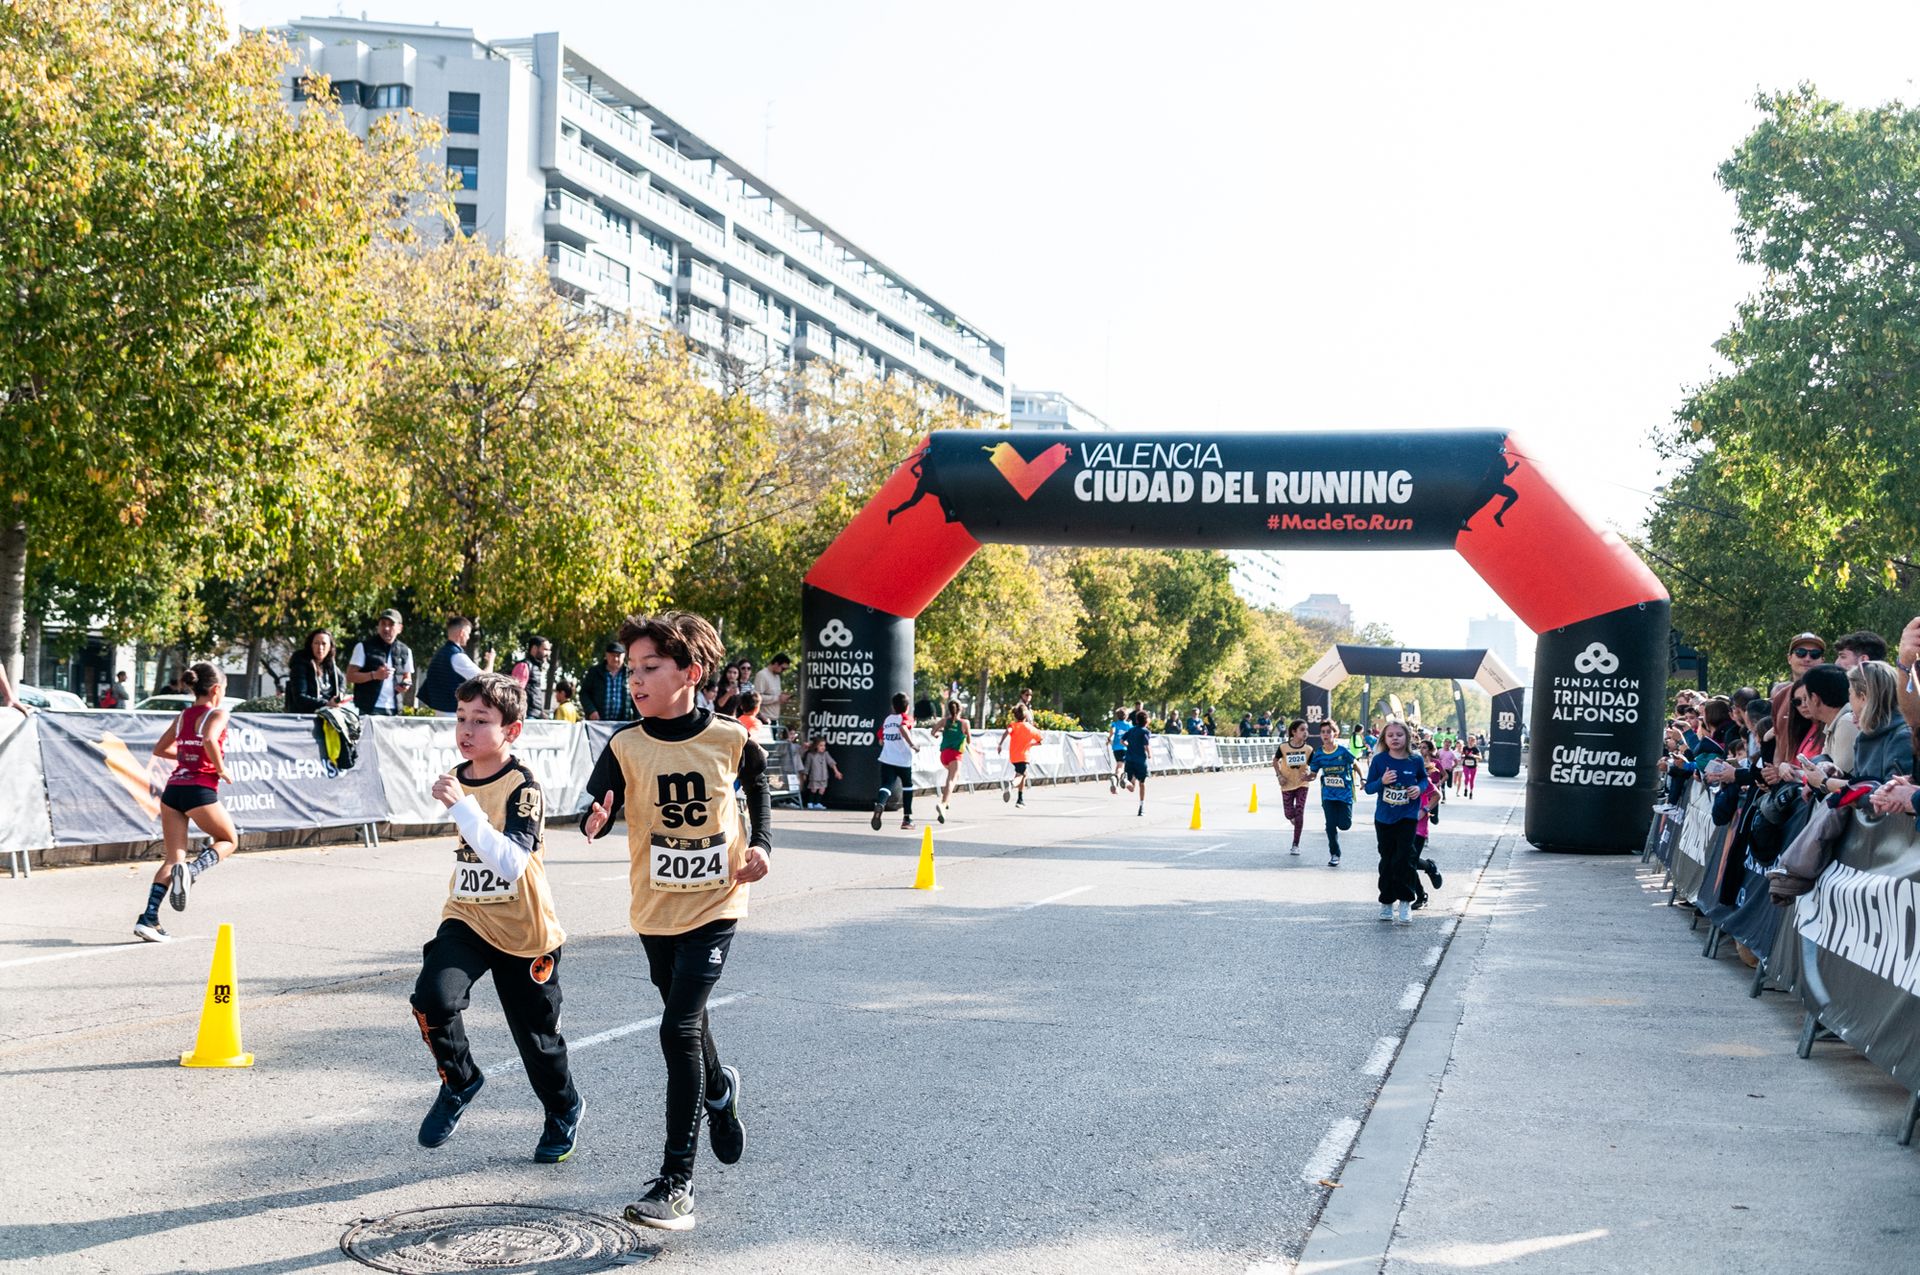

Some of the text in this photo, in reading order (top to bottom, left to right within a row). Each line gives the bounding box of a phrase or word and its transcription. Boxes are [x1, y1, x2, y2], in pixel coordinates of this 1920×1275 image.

[1080, 442, 1223, 469] VALENCIA
[1074, 470, 1414, 504] CIUDAD DEL RUNNING
[1267, 513, 1414, 531] #MadeToRun
[807, 650, 874, 660] FUNDACIÓN
[807, 662, 874, 676] TRINIDAD
[807, 676, 874, 690] ALFONSO
[1554, 677, 1640, 689] FUNDACIÓN
[1553, 690, 1640, 707] TRINIDAD
[808, 711, 859, 728] Cultura
[859, 719, 875, 728] del
[1552, 706, 1639, 724] ALFONSO
[223, 728, 268, 753] ENCIA
[1552, 745, 1637, 767] Cultura del
[1550, 764, 1637, 787] Esfuerzo
[224, 793, 276, 812] ZURICH
[657, 852, 722, 879] 2024
[460, 868, 511, 893] 2024
